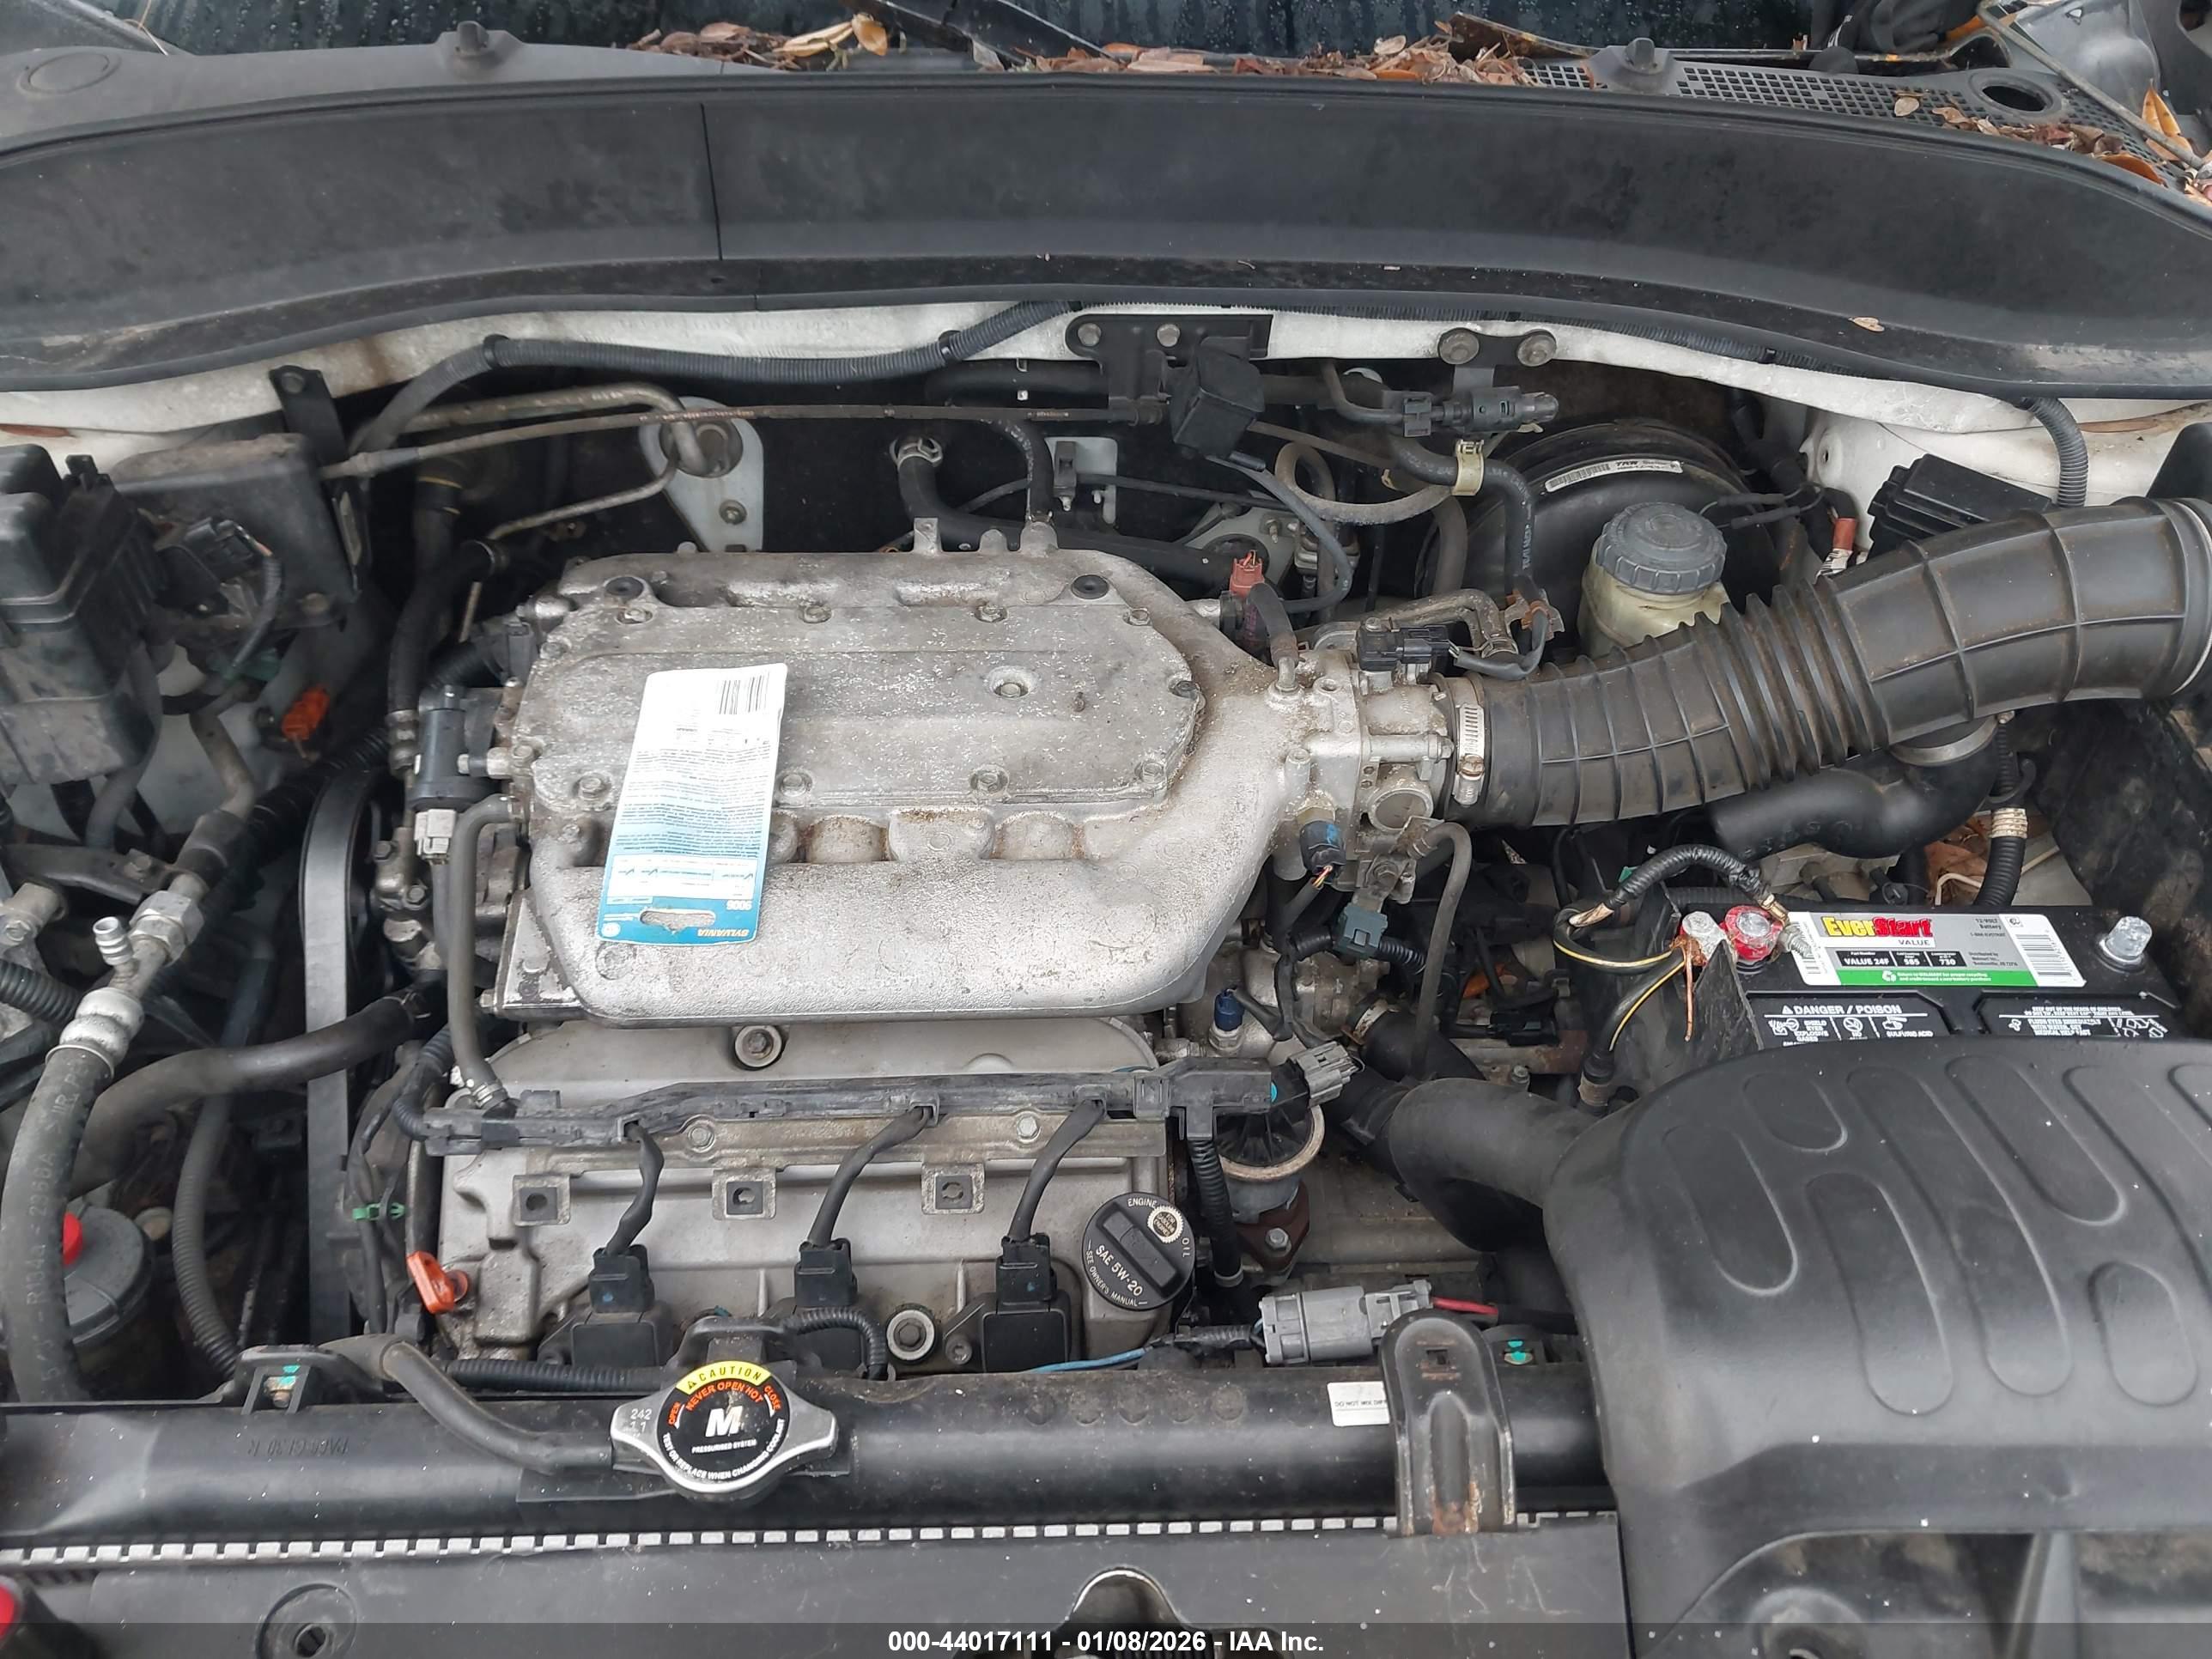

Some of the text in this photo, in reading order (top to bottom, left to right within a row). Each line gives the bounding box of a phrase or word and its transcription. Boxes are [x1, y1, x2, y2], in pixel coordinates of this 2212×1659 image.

[697, 928, 750, 937] SYLVANIA
[1821, 916, 1933, 937] EverStart
[1794, 1005, 1902, 1014] DANGER / POISON
[1127, 1198, 1157, 1209] ENGINE
[1096, 1245, 1114, 1266] SAE
[1182, 1237, 1190, 1257] OIL
[699, 1365, 762, 1382] CAUTION
[686, 1384, 716, 1411] NEVER
[717, 1382, 745, 1392] OPEN
[764, 1385, 781, 1410] CLOSE
[630, 1408, 652, 1420] 242
[667, 1401, 681, 1425] OPEN
[706, 1406, 744, 1437] M
[662, 1418, 786, 1480] TEST OR REPLACE WHEN CHANGING COOLANT
[691, 1438, 757, 1454] PRESSURISED SYSTEM
